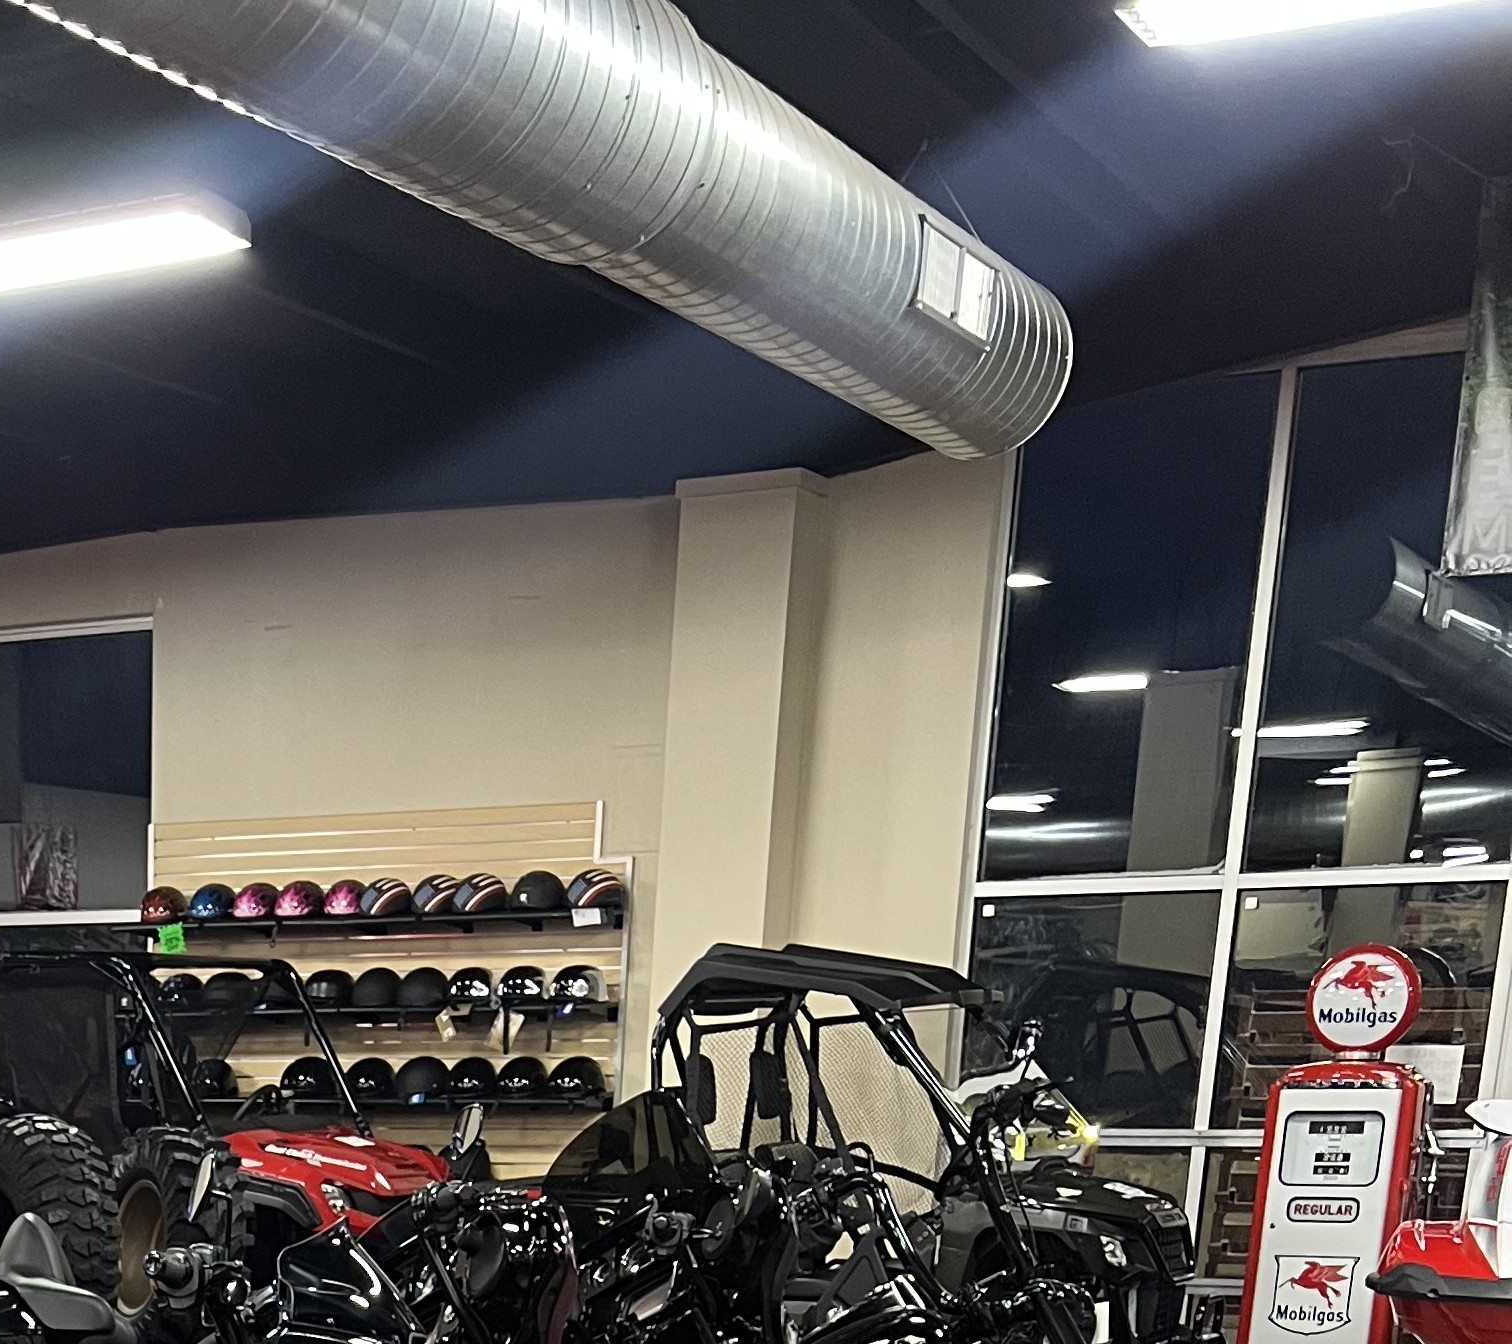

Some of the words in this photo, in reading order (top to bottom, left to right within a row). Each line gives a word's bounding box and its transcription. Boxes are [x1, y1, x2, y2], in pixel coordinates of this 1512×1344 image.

[1319, 1007, 1398, 1027] Mobilgas
[1293, 1203, 1353, 1216] REGULAR
[1276, 1304, 1344, 1326] Mobilgas
